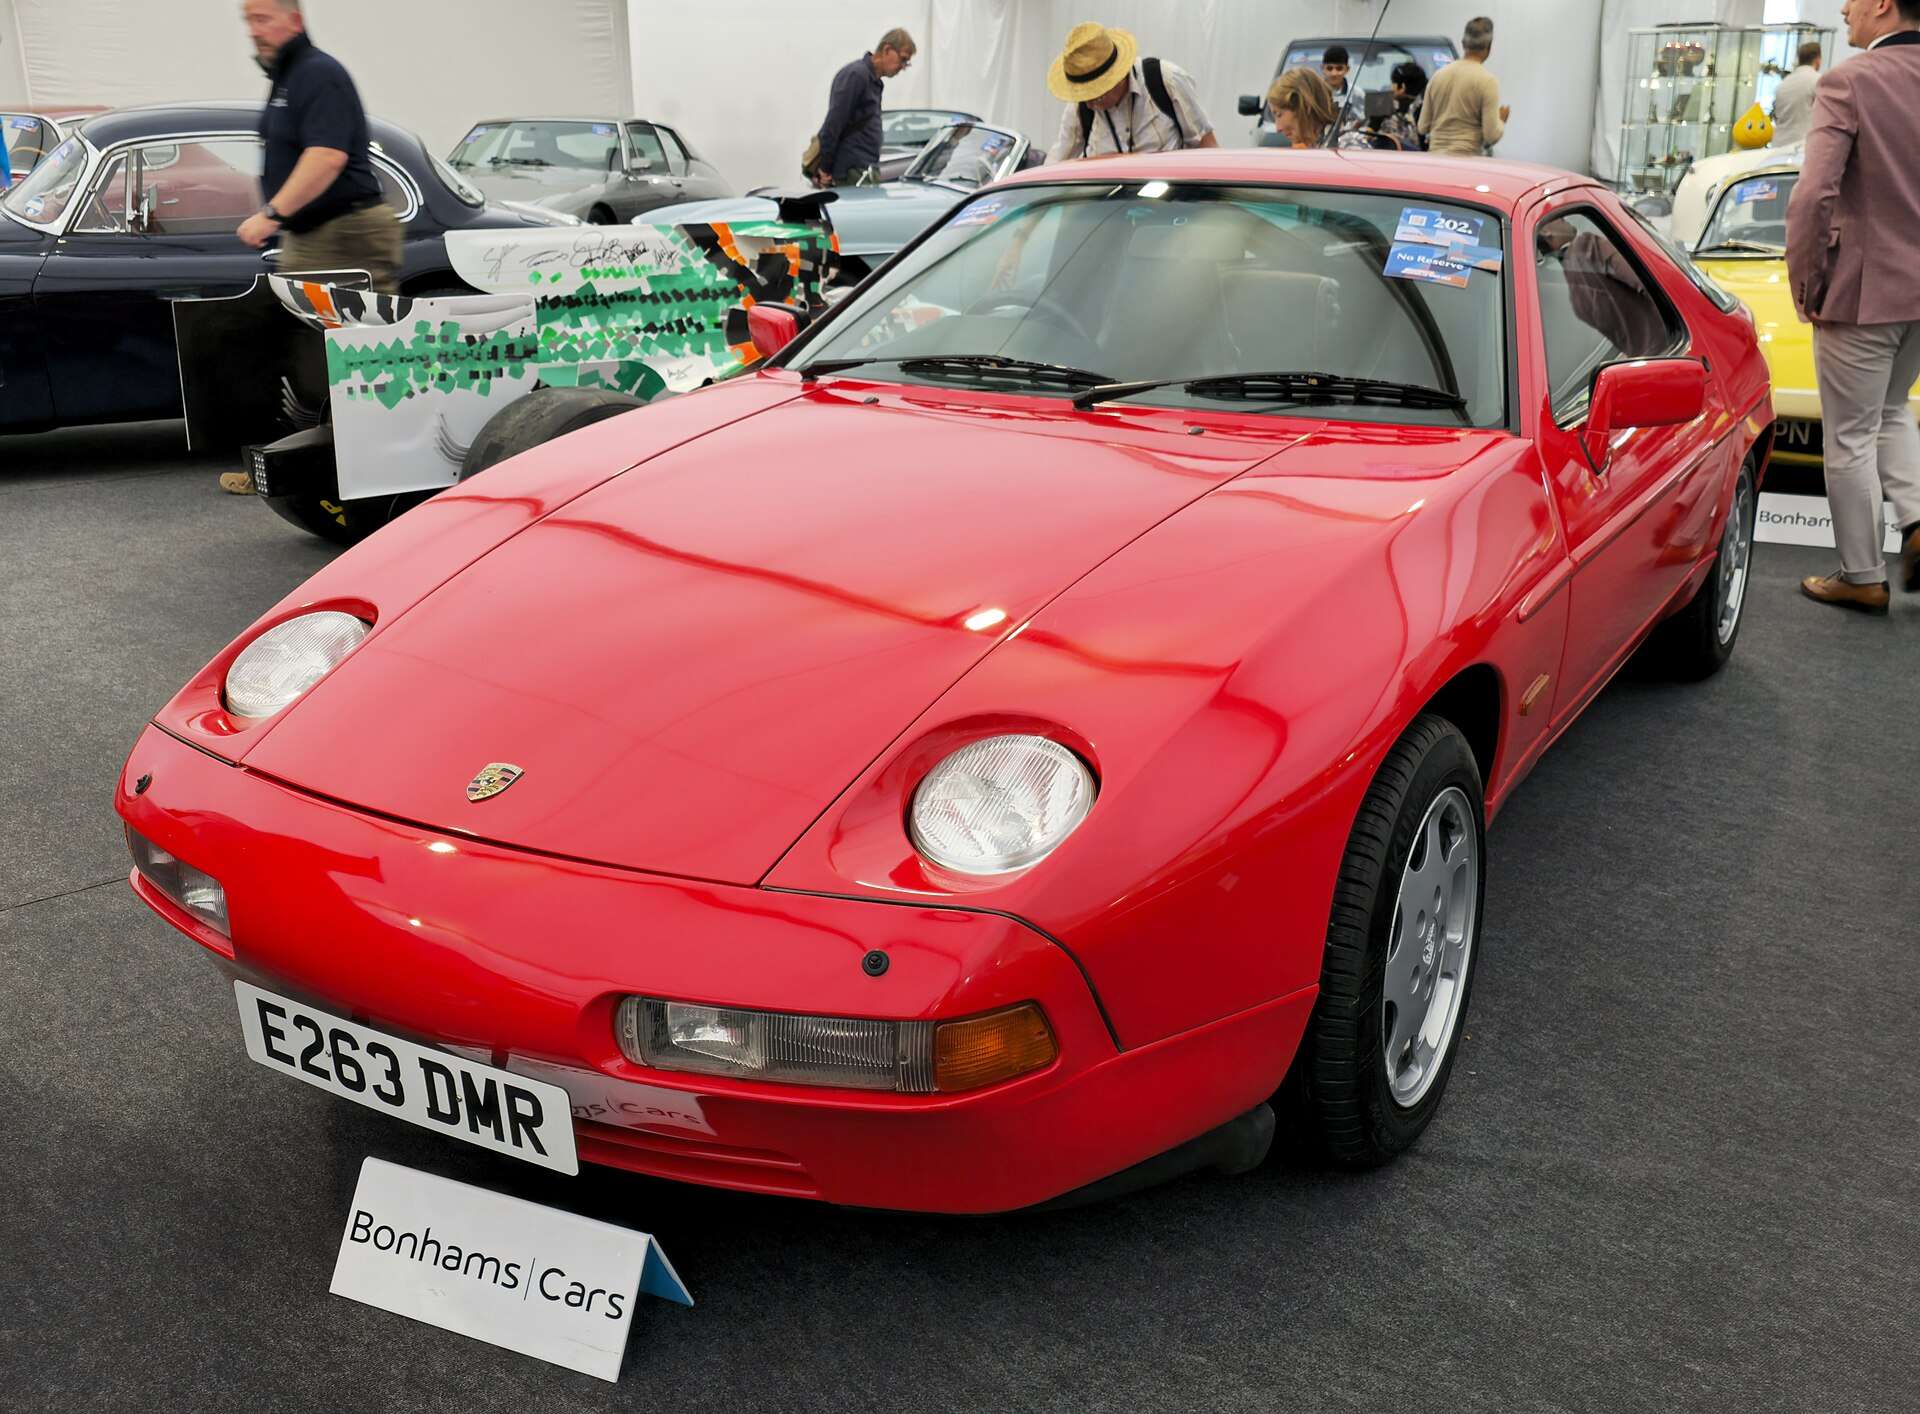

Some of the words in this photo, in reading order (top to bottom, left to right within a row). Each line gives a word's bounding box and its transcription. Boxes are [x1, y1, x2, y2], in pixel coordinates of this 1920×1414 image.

[1396, 252, 1414, 261] No
[1416, 255, 1464, 270] Reserve
[1759, 510, 1833, 527] Bonham
[256, 997, 405, 1108] E263
[418, 1056, 549, 1157] DMR
[350, 1209, 521, 1289] Bonhams
[538, 1267, 625, 1320] Cars
